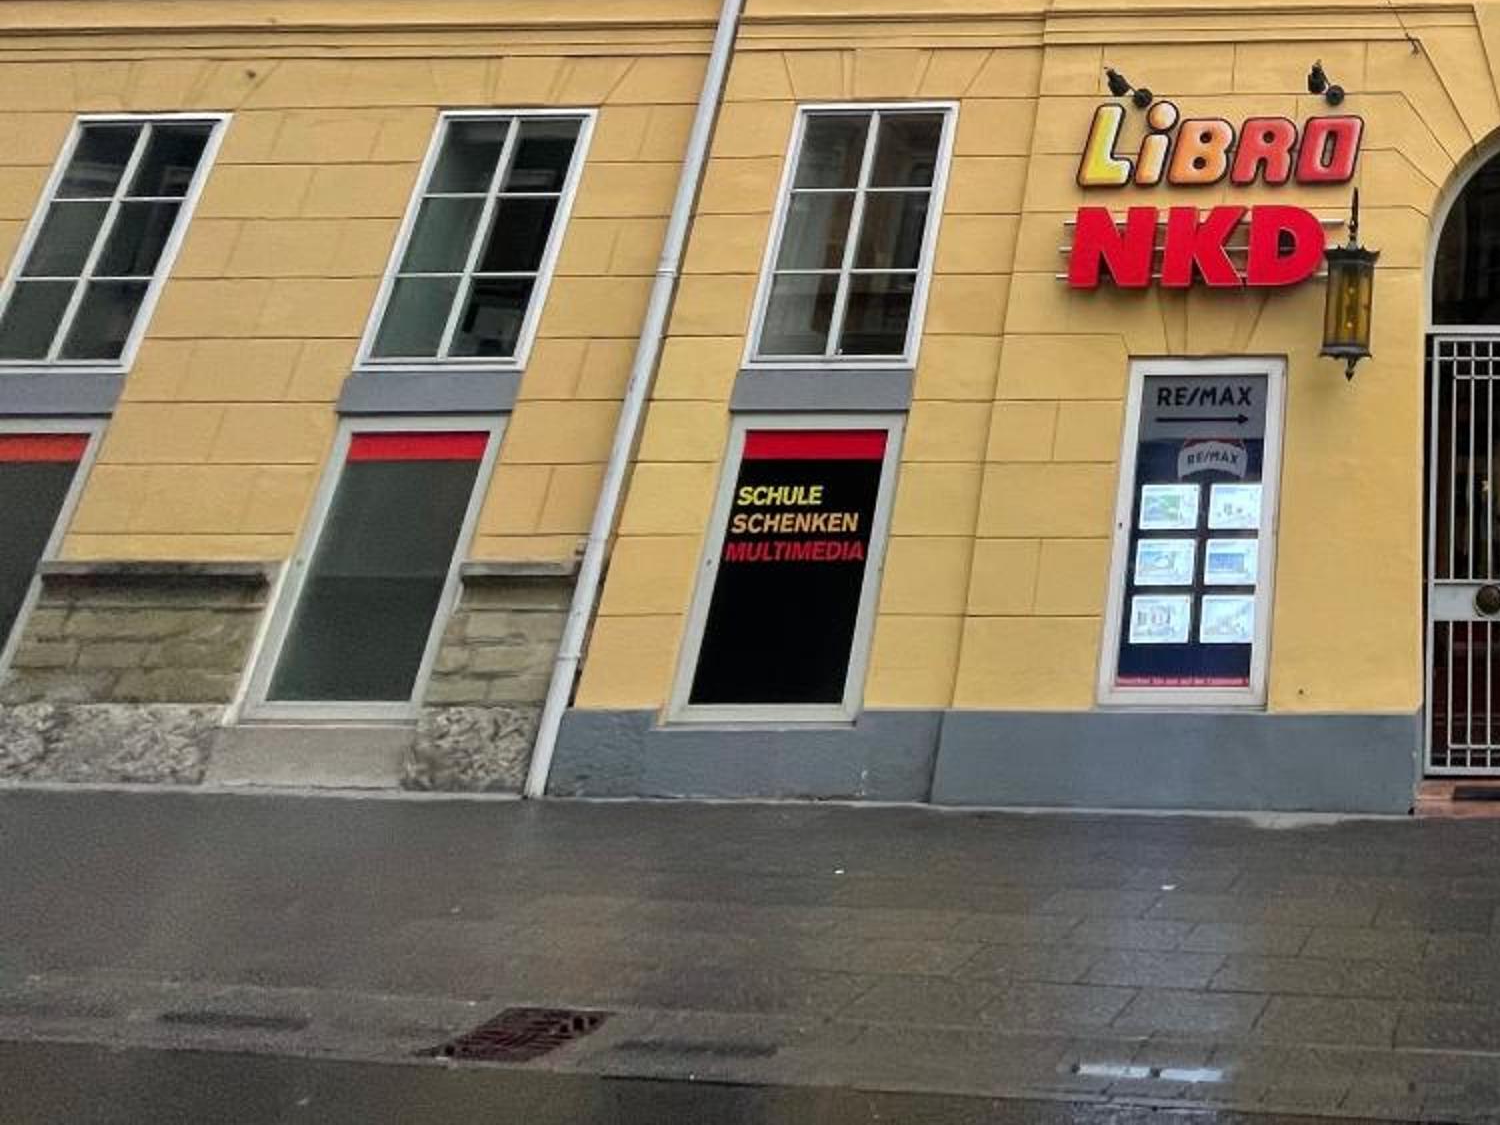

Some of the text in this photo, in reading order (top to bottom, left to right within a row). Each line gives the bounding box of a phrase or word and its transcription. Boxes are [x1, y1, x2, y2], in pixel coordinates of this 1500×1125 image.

[1068, 205, 1325, 288] NKD
[1156, 386, 1252, 407] RE/MAX
[1187, 450, 1238, 465] RE/MAX
[737, 486, 823, 506] SCHULE
[731, 512, 859, 534] SCHENKEN
[725, 541, 864, 562] MULTIMEDIA
